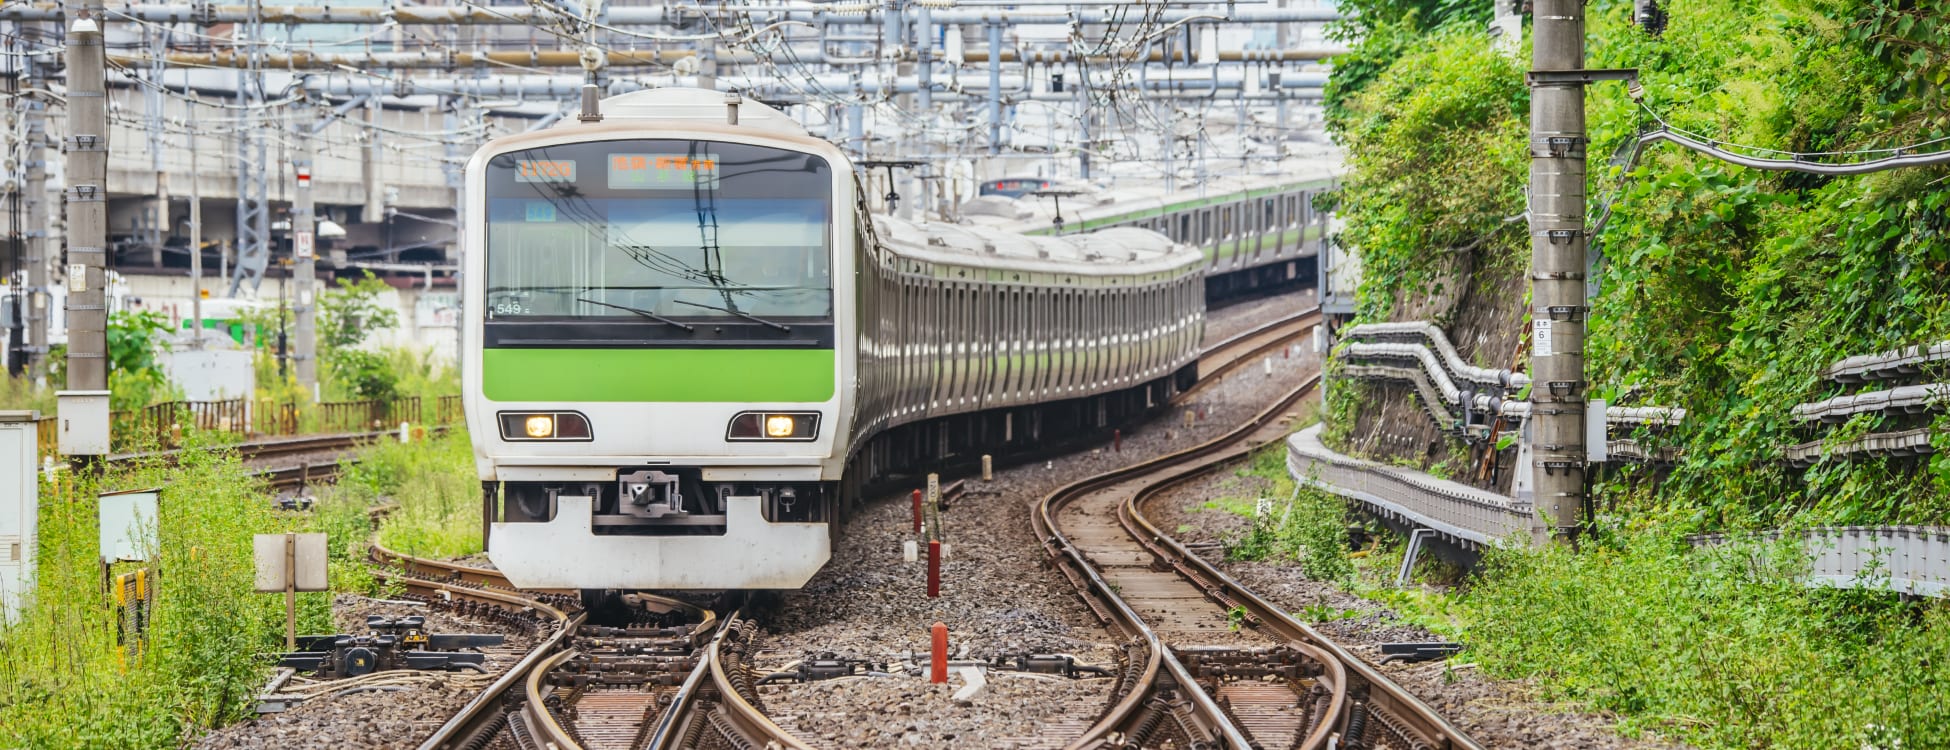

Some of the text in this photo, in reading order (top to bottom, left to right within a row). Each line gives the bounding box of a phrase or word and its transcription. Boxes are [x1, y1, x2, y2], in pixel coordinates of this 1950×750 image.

[521, 161, 571, 177] 1172G
[497, 303, 521, 315] 549
[1538, 330, 1545, 339] 6
